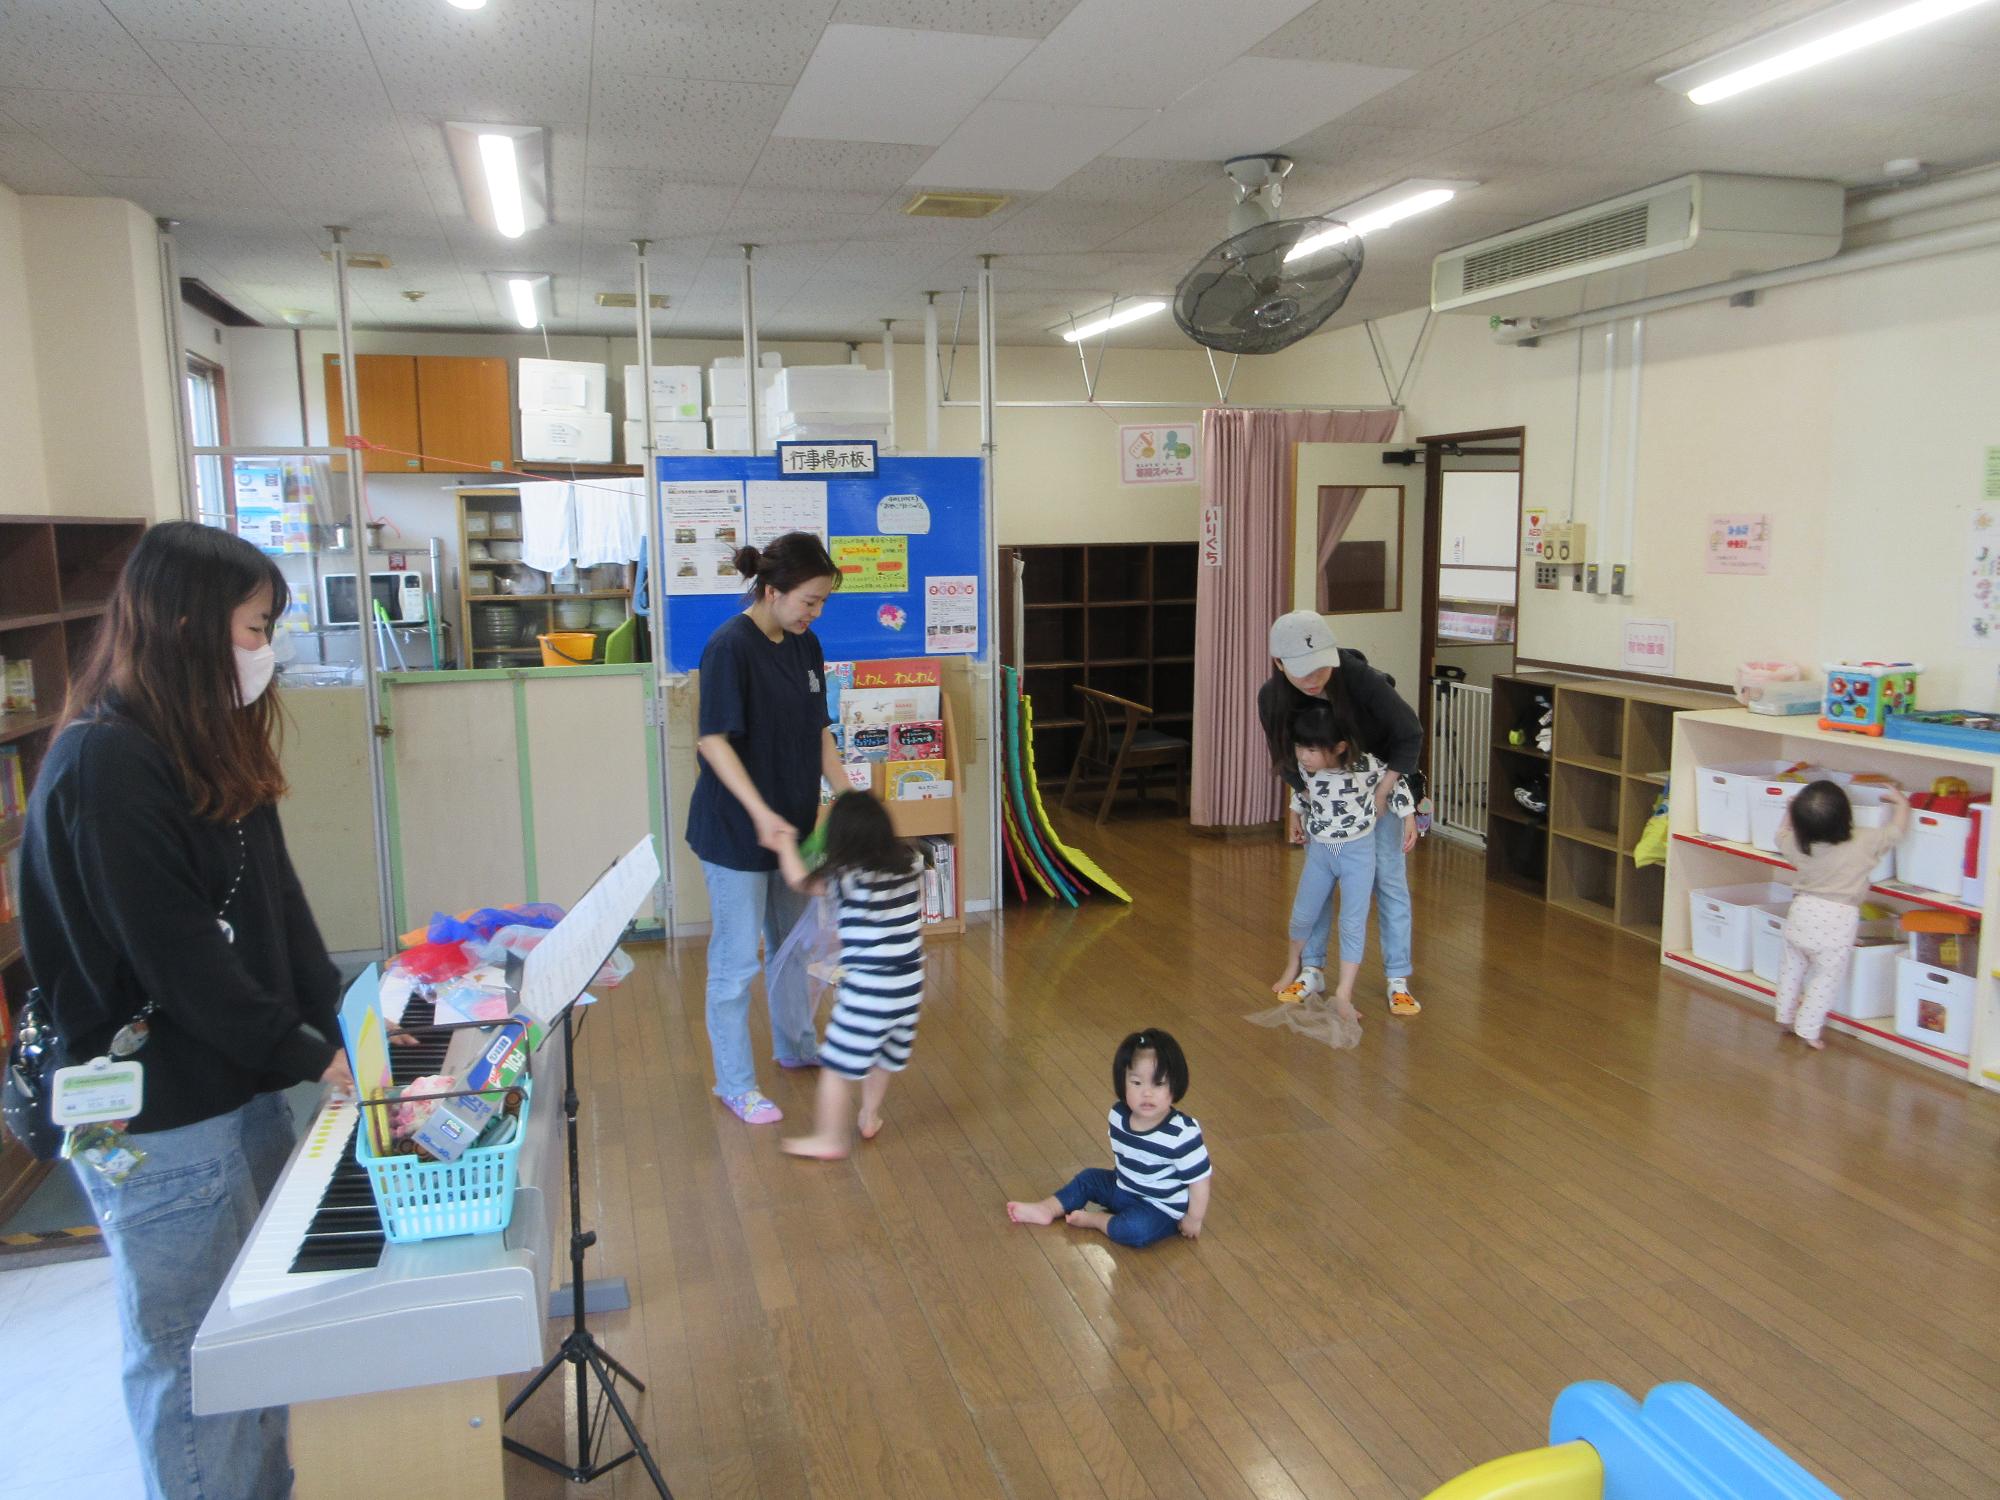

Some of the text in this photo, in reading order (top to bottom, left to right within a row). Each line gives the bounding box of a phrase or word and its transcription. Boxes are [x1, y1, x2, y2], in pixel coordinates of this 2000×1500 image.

[1205, 509, 1218, 565] いりぐち
[1528, 528, 1542, 537] AED
[894, 671, 937, 684] わんわん
[501, 1047, 527, 1073] FOIL
